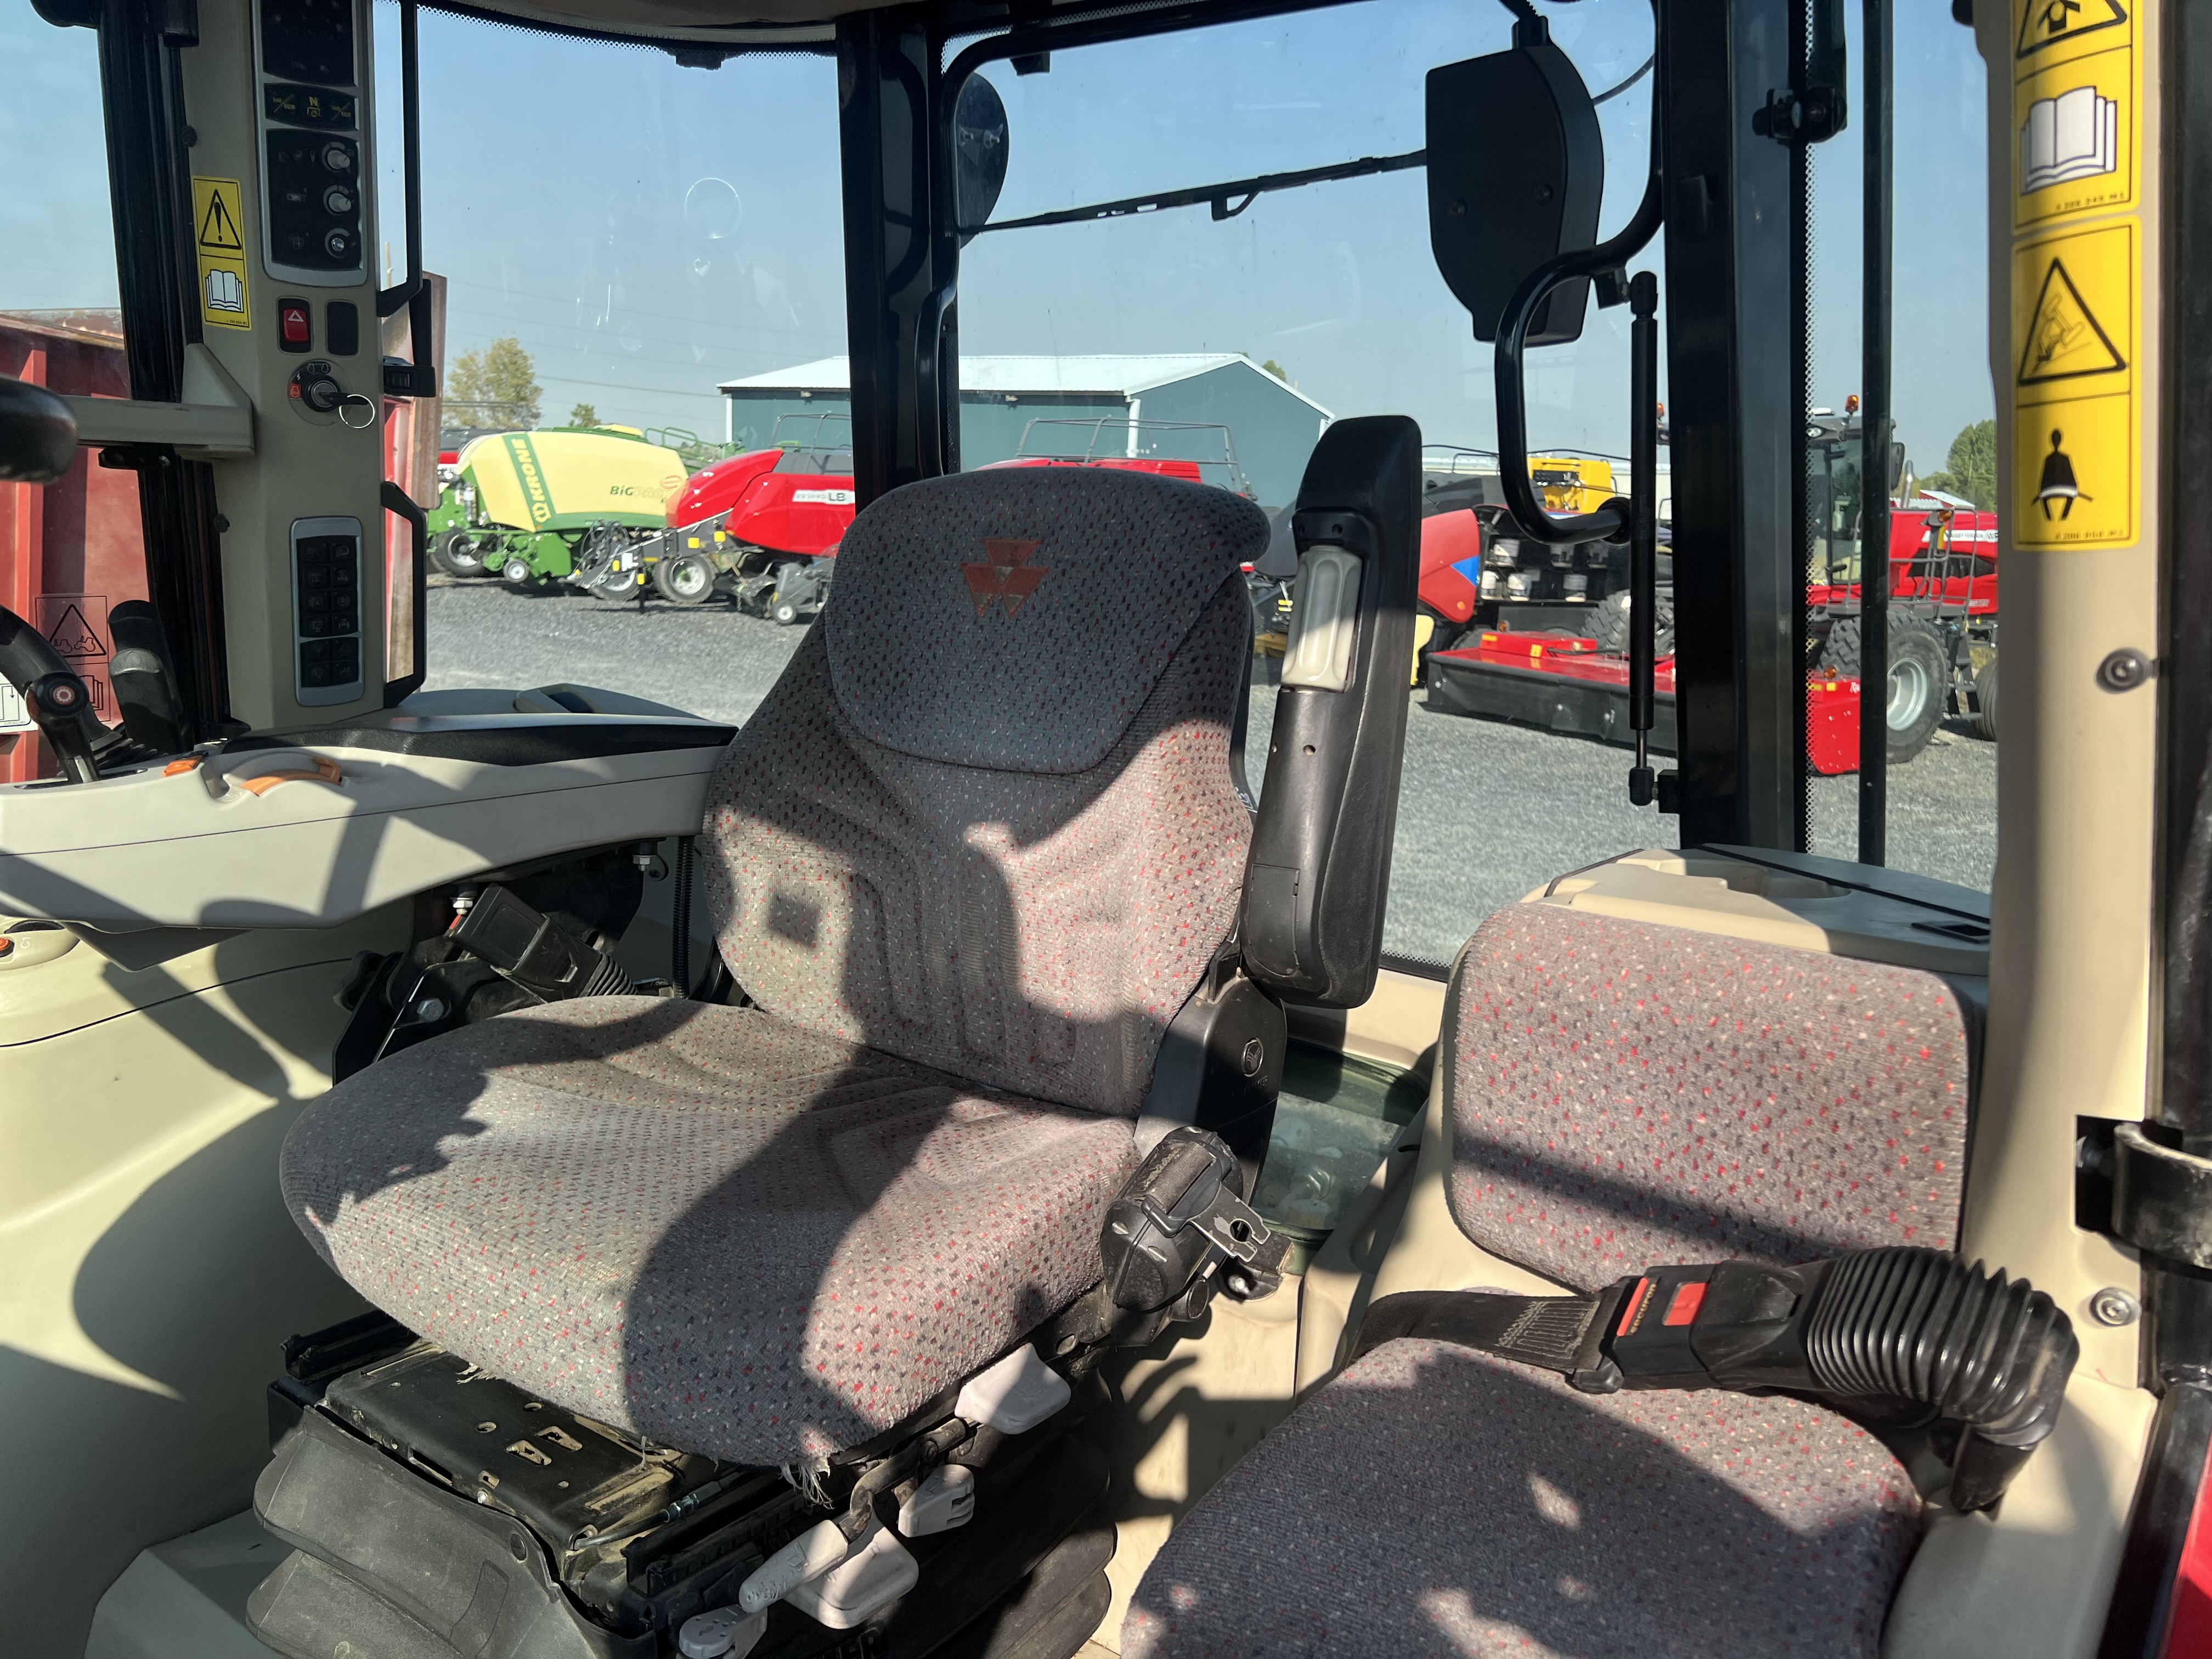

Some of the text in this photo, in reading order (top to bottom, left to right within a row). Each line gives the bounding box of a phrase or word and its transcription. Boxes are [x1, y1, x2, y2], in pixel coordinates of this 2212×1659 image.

[309, 96, 319, 106] N
[511, 438, 546, 501] KRONE
[20, 936, 31, 949] C1
